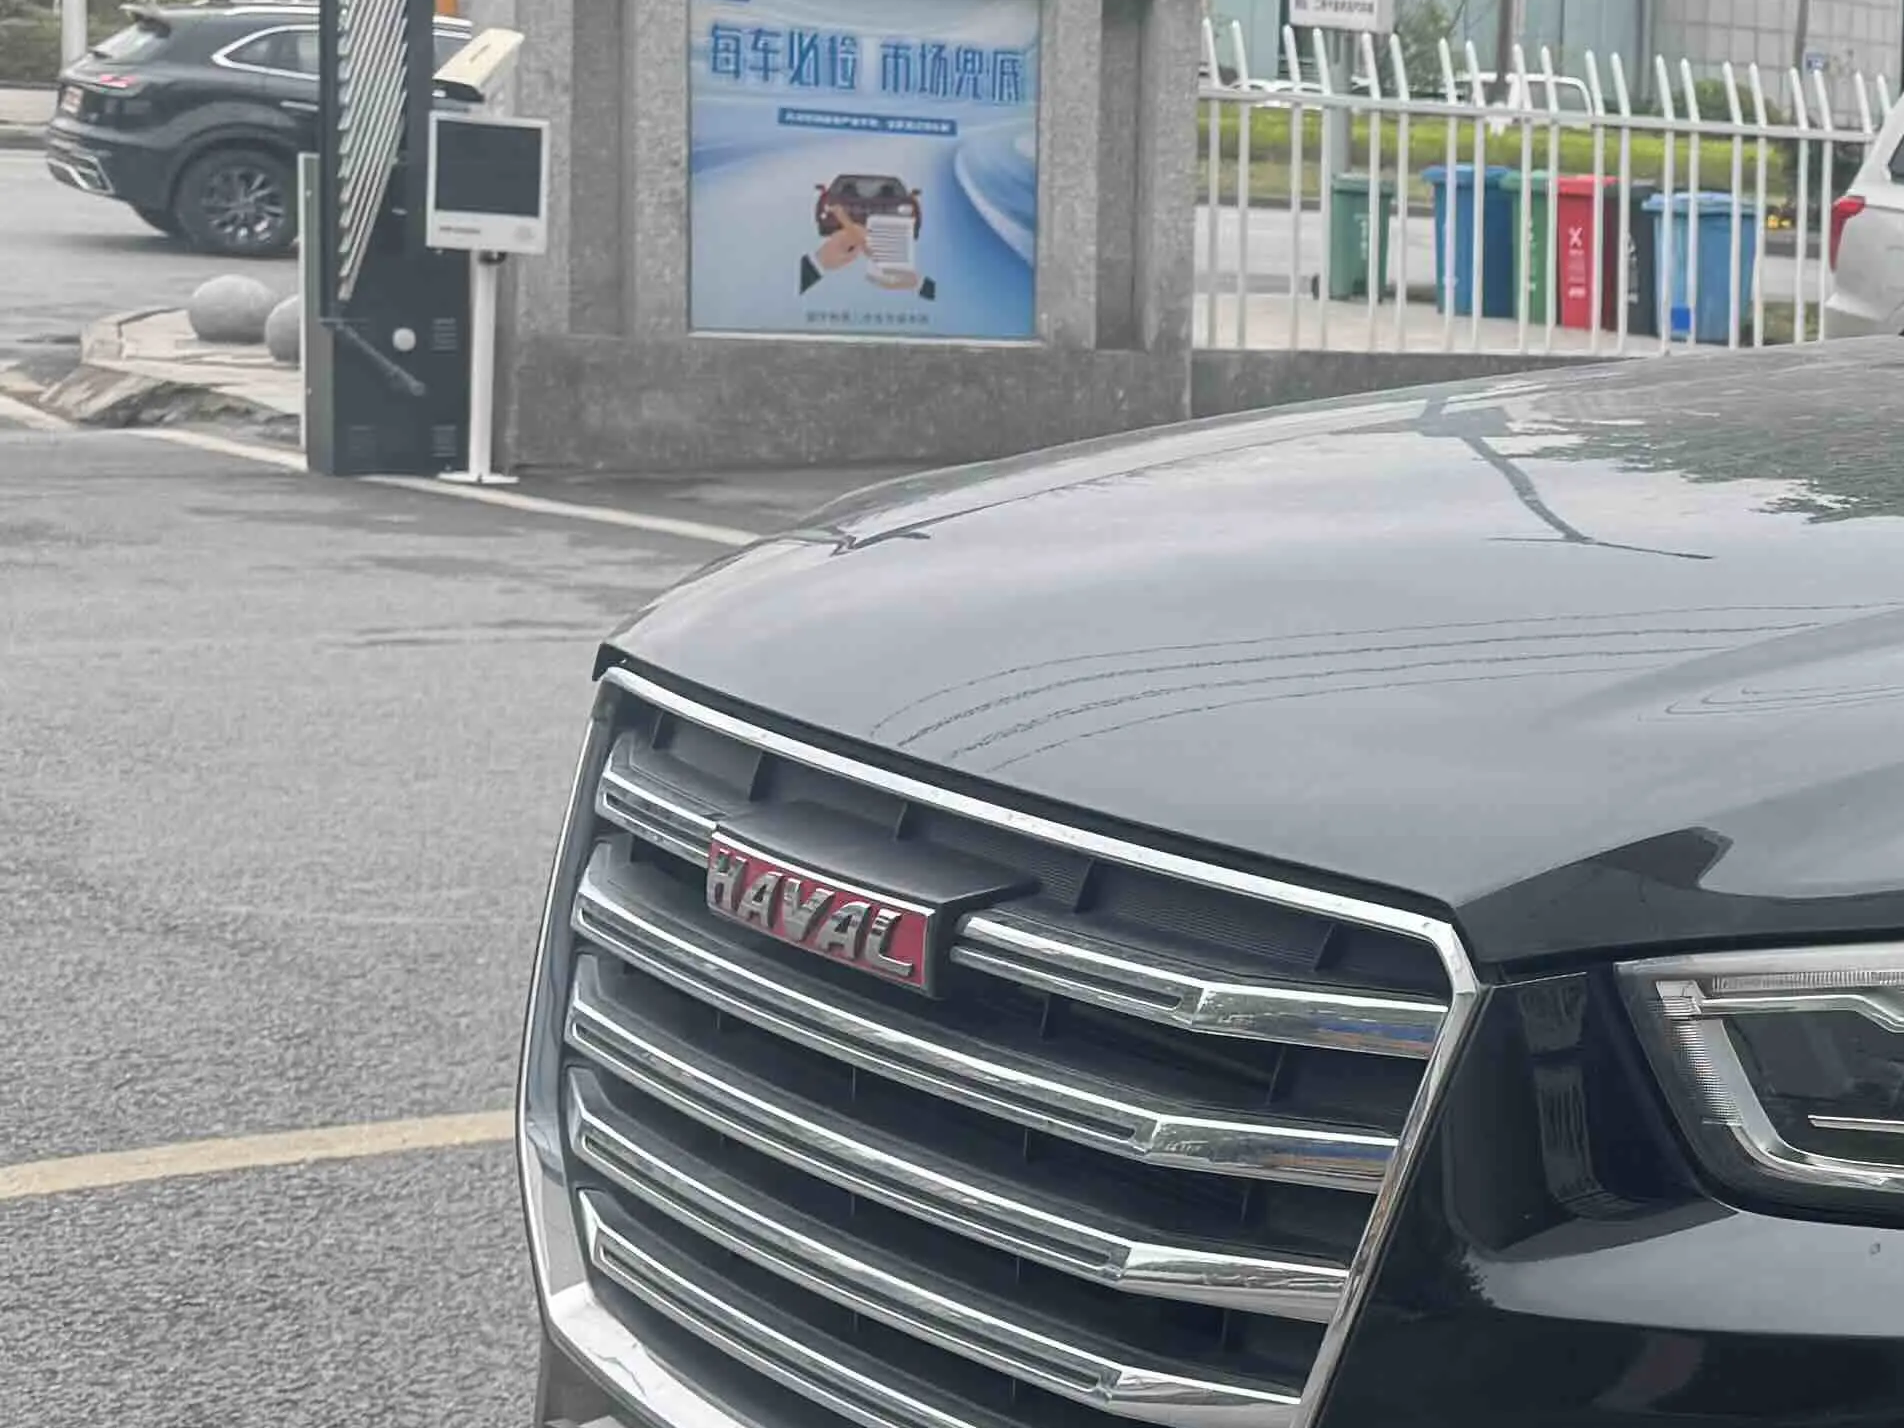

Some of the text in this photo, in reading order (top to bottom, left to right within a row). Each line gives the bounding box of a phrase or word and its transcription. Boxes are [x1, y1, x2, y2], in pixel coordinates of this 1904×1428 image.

[711, 23, 1026, 103] 每车必检 市场兜底
[707, 848, 914, 977] HAVAL
